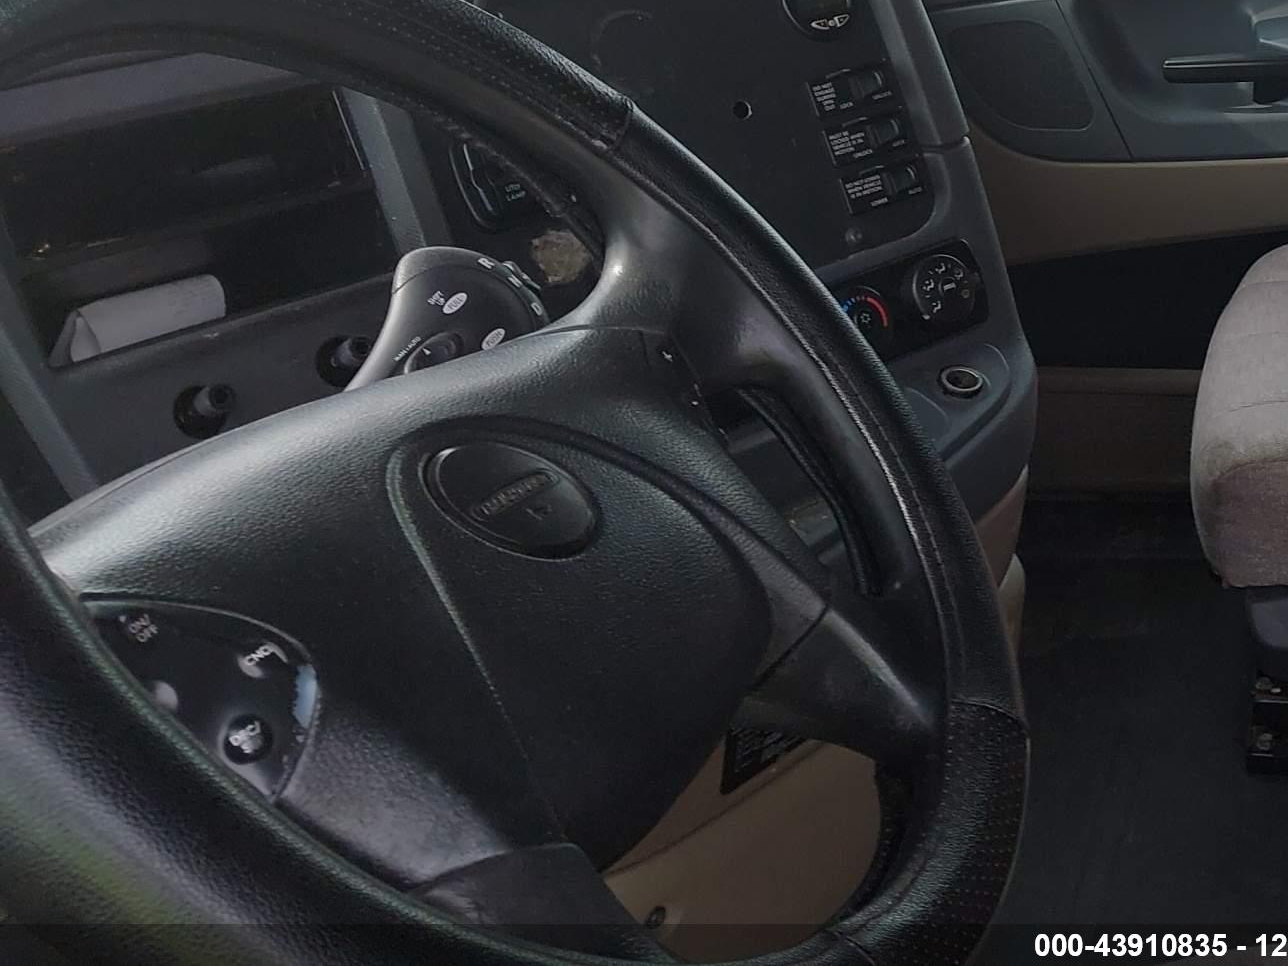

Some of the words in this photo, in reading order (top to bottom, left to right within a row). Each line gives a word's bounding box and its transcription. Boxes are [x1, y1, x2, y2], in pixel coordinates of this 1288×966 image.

[477, 257, 495, 270] R
[507, 274, 523, 288] N
[530, 302, 544, 316] D
